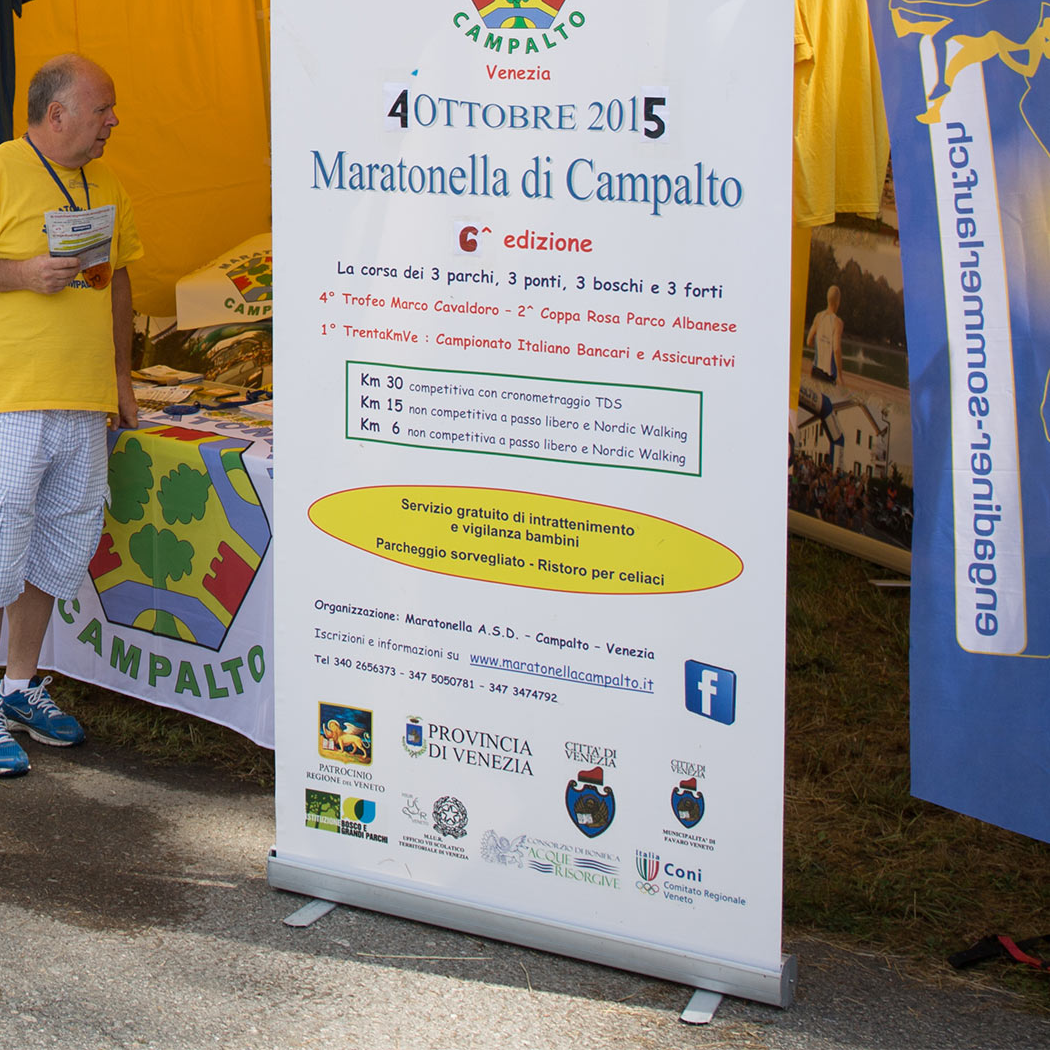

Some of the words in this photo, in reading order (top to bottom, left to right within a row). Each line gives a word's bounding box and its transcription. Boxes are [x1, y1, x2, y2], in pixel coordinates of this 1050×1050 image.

[452, 10, 586, 54] CAMPALTO
[486, 64, 550, 80] Venezia
[588, 96, 666, 140] 2015
[310, 150, 510, 196] Maratonella
[522, 156, 554, 198] di
[566, 158, 742, 216] Campalto
[504, 230, 592, 252] edizione
[338, 260, 354, 276] La
[360, 266, 398, 278] corsa
[404, 264, 424, 280] dei
[430, 266, 440, 280] 3
[448, 268, 500, 286] parchi,
[508, 272, 518, 286] 3
[524, 274, 566, 292] ponti,
[576, 276, 586, 290] 3
[594, 276, 644, 294] boschi
[668, 280, 676, 296] 3
[684, 282, 724, 298] forti
[342, 292, 386, 308] Trofeo
[390, 296, 428, 312] Marco
[434, 300, 500, 316] Cavaldoro
[540, 306, 580, 324] Coppa
[588, 310, 620, 324] Rosa
[626, 312, 666, 328] Parco
[672, 316, 736, 332] Albanese
[342, 324, 418, 344] TrentaKmVe
[436, 334, 512, 350] Campionato
[518, 338, 570, 354] Italiano
[576, 342, 630, 358] Bancari
[652, 350, 734, 368] Assicurativi
[360, 372, 380, 388] Km
[386, 376, 404, 390] 30
[408, 384, 474, 396] competitiva
[478, 388, 498, 398] con
[500, 390, 590, 410] cronometraggio
[594, 396, 622, 410] TDS
[360, 394, 380, 410] Km
[388, 398, 404, 412] 15
[408, 406, 428, 416] non
[430, 408, 498, 422] competitiva
[510, 414, 542, 426] passo
[546, 416, 580, 430] libero
[594, 420, 636, 434] Nordic
[640, 424, 688, 444] Walking
[360, 416, 380, 432] Km
[392, 422, 400, 436] 6
[408, 428, 426, 438] non
[430, 430, 496, 444] competitiva
[510, 438, 540, 450] passo
[544, 438, 578, 454] libero
[592, 444, 634, 458] Nordic
[638, 448, 686, 468] Walking
[402, 498, 454, 516] Servizio
[456, 506, 510, 522] gratuito
[512, 512, 526, 524] di
[530, 512, 636, 536] intrattenimento
[462, 522, 522, 540] vigilanza
[526, 528, 580, 548] bambini
[376, 536, 446, 560] Parcheggio
[450, 550, 526, 568] sorvegliato
[538, 558, 588, 576] Ristoro
[592, 568, 616, 580] per
[618, 570, 664, 586] celiaci
[314, 600, 400, 622] Organizzazione:
[404, 614, 472, 632] Maratonella
[478, 624, 518, 640] A.S.D.
[536, 632, 590, 650] Campalto
[606, 642, 654, 660] Venezia
[314, 628, 364, 644] Iscrizioni
[377, 638, 444, 658] informazioni
[446, 652, 460, 660] su
[469, 653, 654, 691] www.maratonellacampalto.it
[314, 654, 330, 664] Tel
[334, 656, 352, 668] 340
[356, 660, 396, 676] 2656373
[408, 670, 428, 682] 347
[430, 674, 474, 690] 5050781
[488, 682, 508, 694] 347
[512, 686, 558, 704] 3474792
[428, 723, 534, 757] PROVINCIA
[318, 764, 372, 781] PATROCINIO
[428, 742, 446, 760] DI
[452, 746, 534, 776] VENEZIA
[306, 772, 340, 784] REGIONE
[354, 781, 385, 793] VENETO
[341, 820, 361, 830] BOSCO
[341, 828, 364, 840] GRANDI
[366, 832, 388, 844] PARCHI
[445, 850, 469, 860] VENEZIA
[528, 847, 572, 865] ACQUE
[664, 836, 688, 845] FAVARO
[690, 842, 714, 851] VENETO
[555, 865, 621, 889] RISORGIVE
[664, 863, 702, 882] Coni
[663, 881, 702, 896] Comitato
[704, 889, 746, 906] Regionale
[664, 892, 693, 904] Veneto
